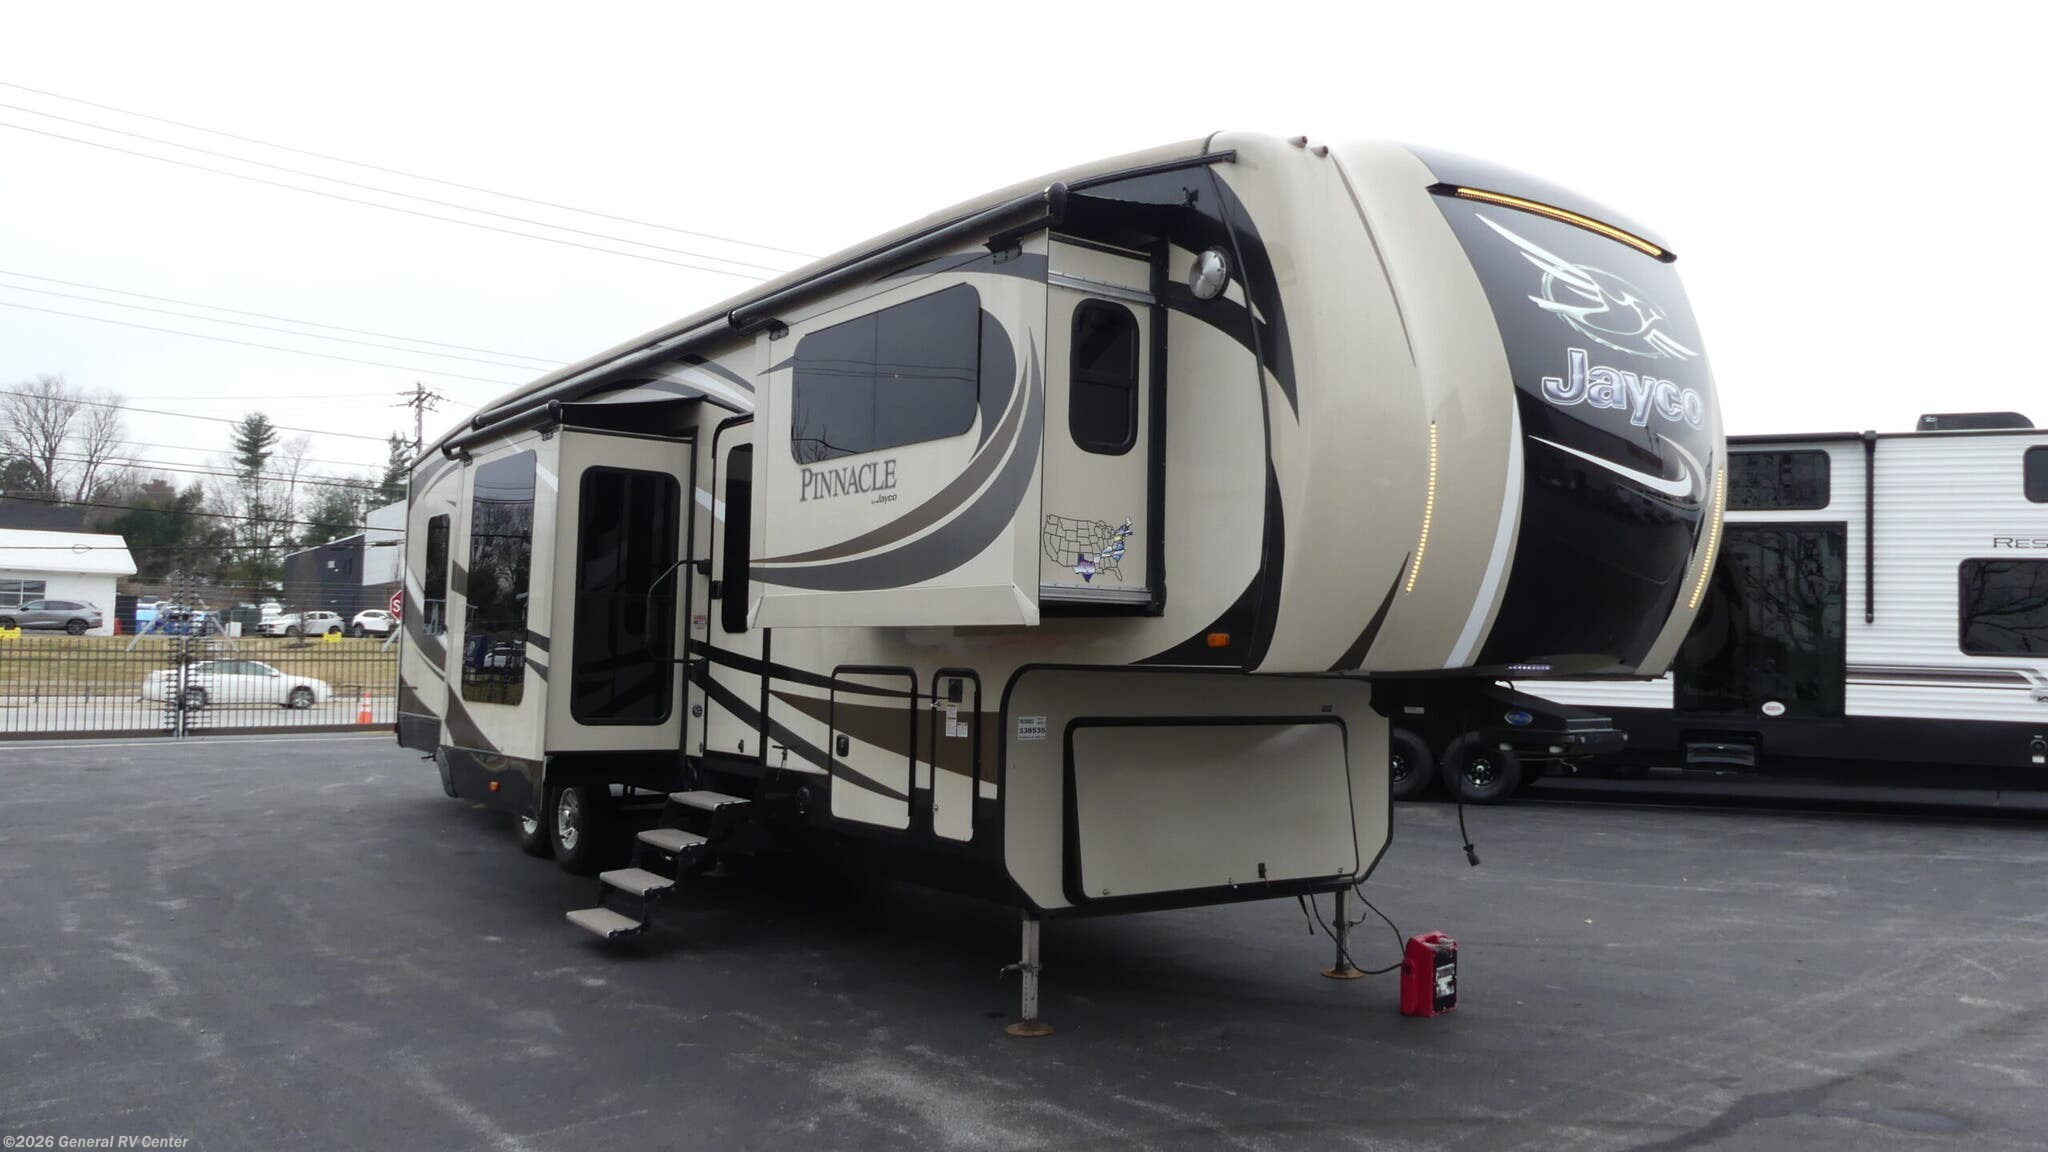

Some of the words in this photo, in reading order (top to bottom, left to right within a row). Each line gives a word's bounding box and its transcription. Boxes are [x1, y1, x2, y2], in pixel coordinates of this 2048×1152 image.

[1541, 347, 1704, 430] Jayco
[800, 459, 897, 502] PINNACLE
[877, 494, 898, 505] Jayco
